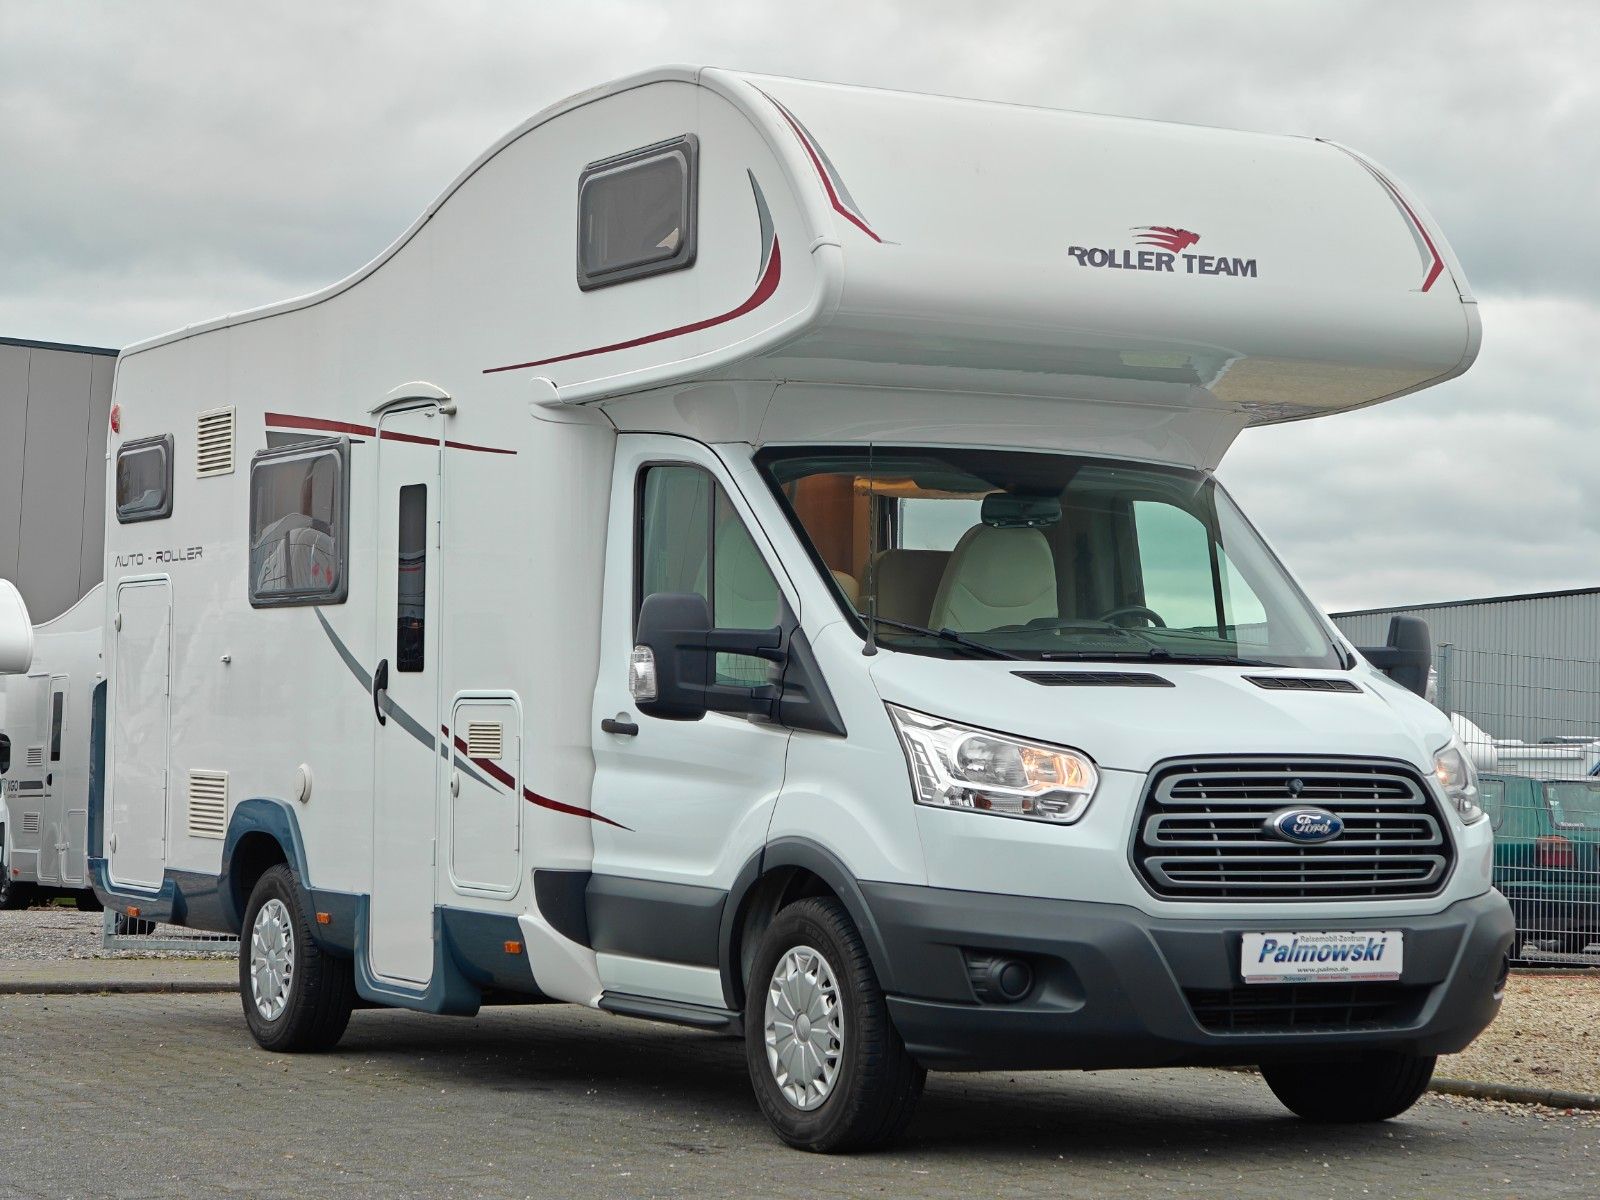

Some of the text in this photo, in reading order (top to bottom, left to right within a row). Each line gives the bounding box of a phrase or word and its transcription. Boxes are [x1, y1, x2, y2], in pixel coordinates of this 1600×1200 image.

[1067, 245, 1258, 278] ROLLER TEAM
[114, 553, 144, 568] AUTO
[155, 546, 203, 564] ROLLER
[1293, 814, 1331, 835] Ford
[1258, 937, 1388, 963] Palmowski
